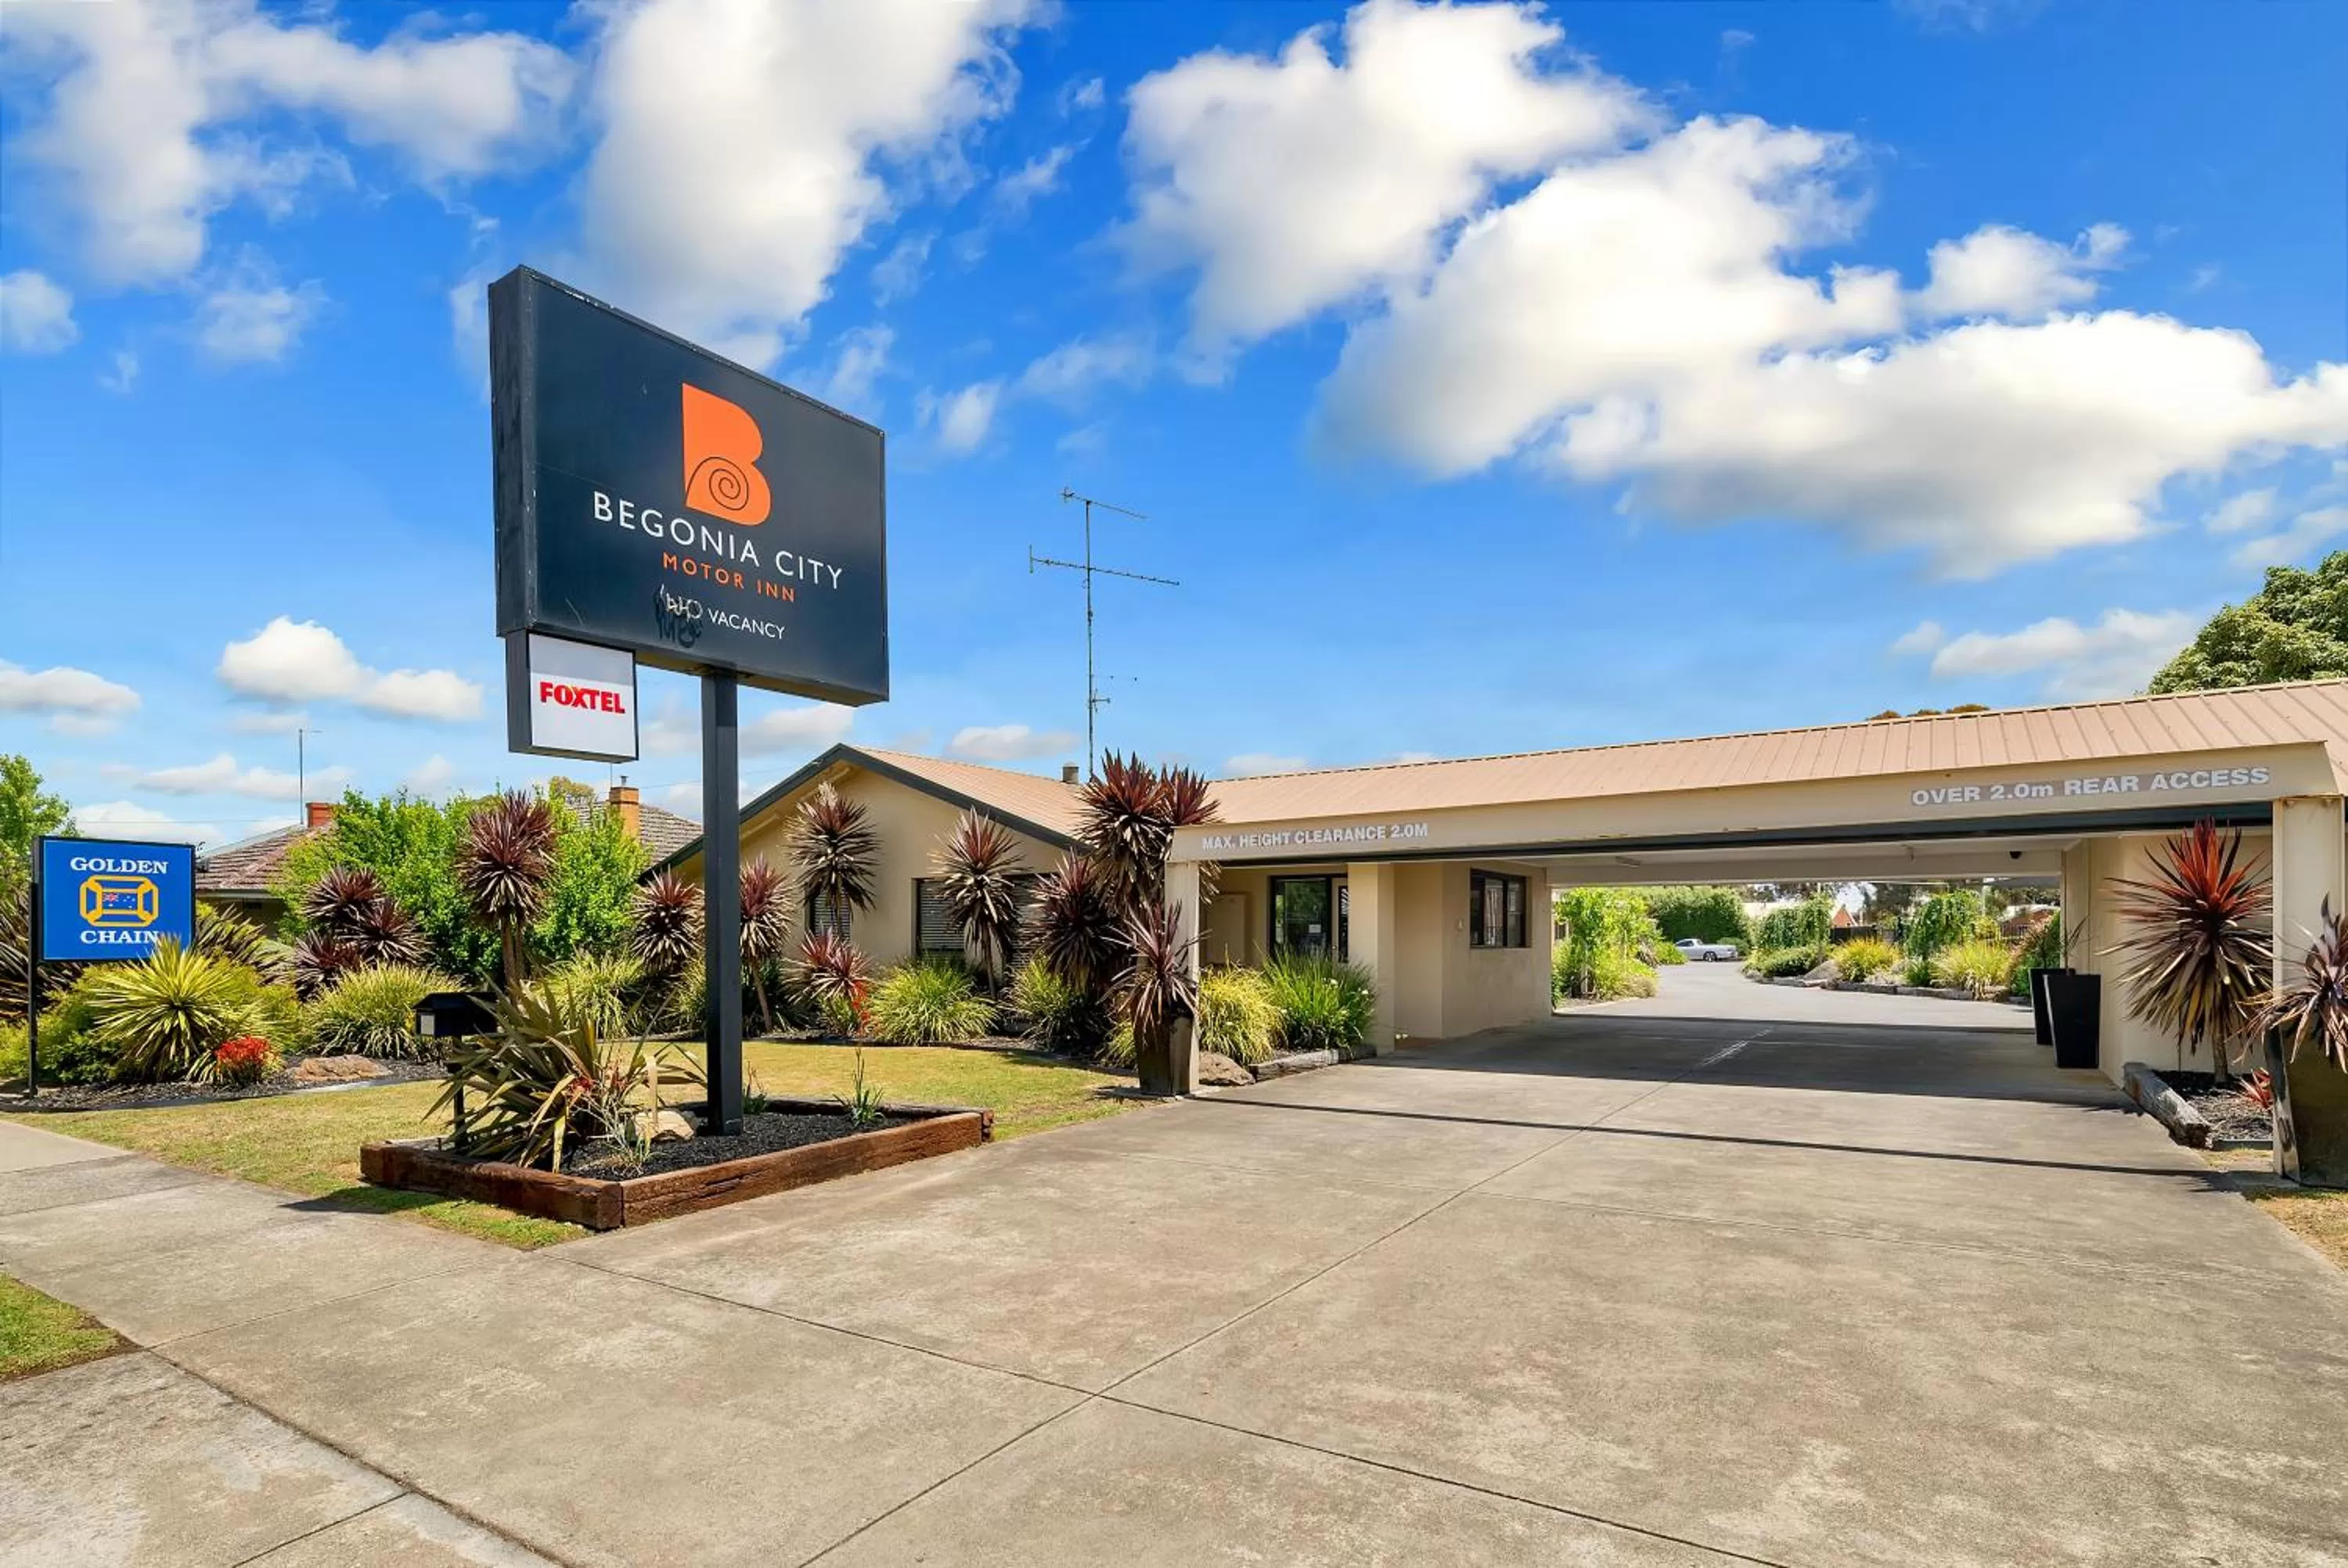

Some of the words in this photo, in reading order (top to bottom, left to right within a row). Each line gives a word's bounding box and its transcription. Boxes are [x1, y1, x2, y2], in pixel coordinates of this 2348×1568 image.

[682, 383, 772, 526] B
[593, 491, 760, 567] BEGONIA
[775, 550, 843, 589] CITY
[663, 551, 744, 588] MOTOR
[757, 580, 795, 602] INN
[707, 607, 785, 639] VACANCY
[539, 682, 626, 714] FOXTEL
[1912, 787, 1980, 805] OVER
[1990, 782, 2054, 800] 2.0m
[2064, 775, 2139, 796] REAR
[2150, 767, 2269, 789] ACCESS
[1201, 836, 1236, 851] MAX.
[1239, 832, 1291, 848] HEIGHT
[1294, 825, 1386, 844] CLEARANCE
[1390, 822, 1428, 839] 2.0M
[70, 857, 169, 874] GOLDEN
[80, 930, 160, 944] CHAIN
